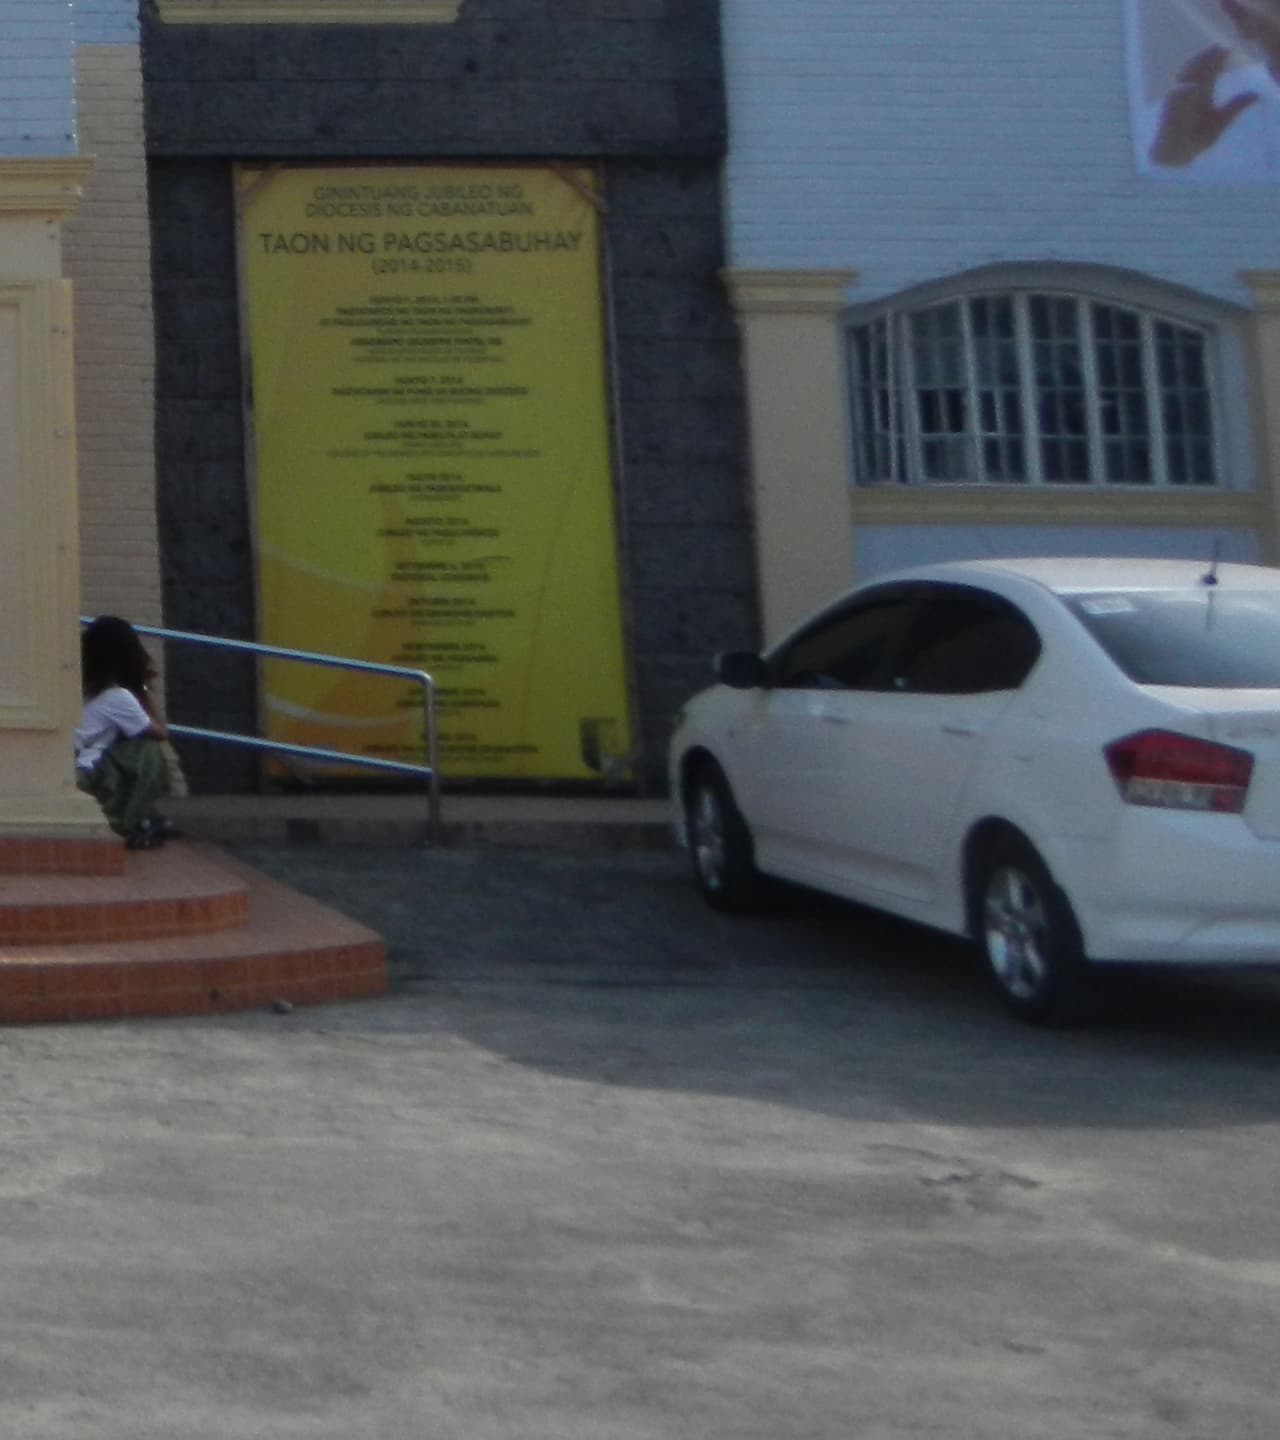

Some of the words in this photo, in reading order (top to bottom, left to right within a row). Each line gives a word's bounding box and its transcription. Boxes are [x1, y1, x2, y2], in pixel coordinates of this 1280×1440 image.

[313, 186, 419, 200] GININTUANG
[425, 185, 491, 200] JUBILEO
[497, 184, 523, 199] NG
[306, 203, 384, 217] DIOCESIS
[389, 203, 412, 216] NG
[415, 202, 534, 216] CABANATUAN
[259, 233, 329, 254] TAON
[338, 233, 375, 254] NG
[383, 231, 583, 253] PAGSASABUHAY
[371, 258, 473, 275] (2014-2015)
